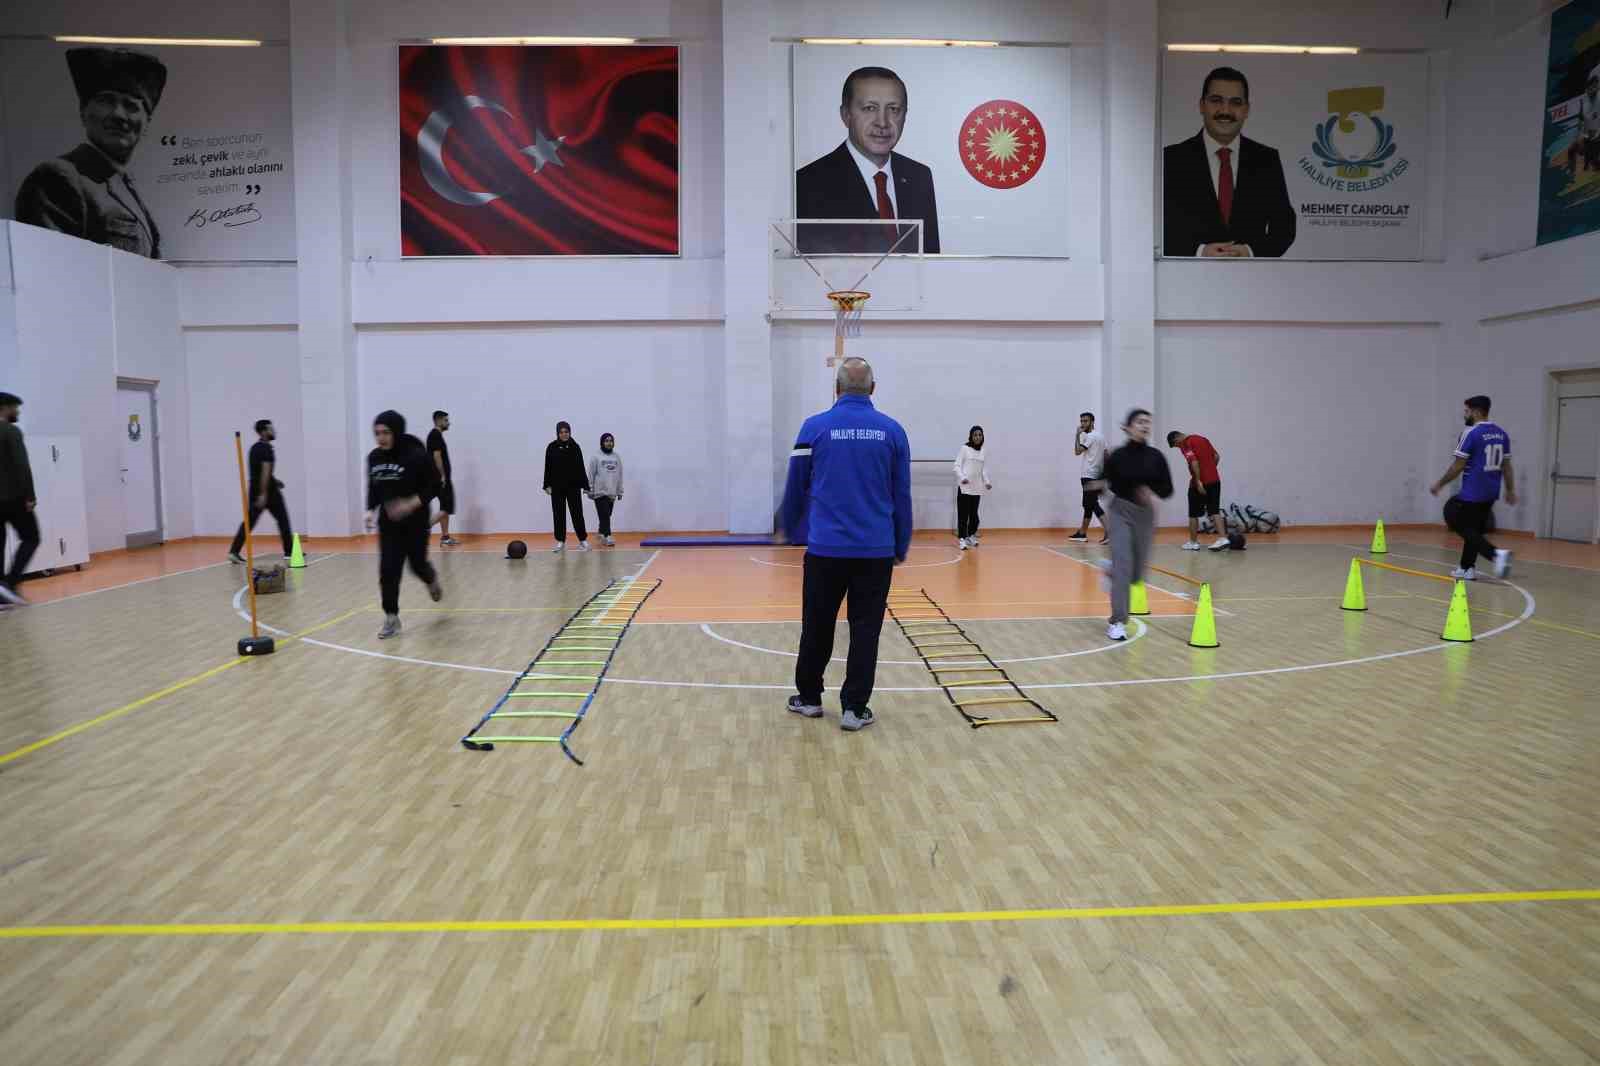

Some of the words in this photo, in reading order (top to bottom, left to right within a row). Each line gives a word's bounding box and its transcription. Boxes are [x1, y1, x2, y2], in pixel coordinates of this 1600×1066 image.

[200, 151, 229, 166] çevik
[209, 165, 245, 178] ahlaklı
[247, 162, 283, 175] olanını
[1301, 203, 1349, 215] MEHMET
[1351, 203, 1410, 216] CANPOLAT
[1483, 444, 1503, 471] 10
